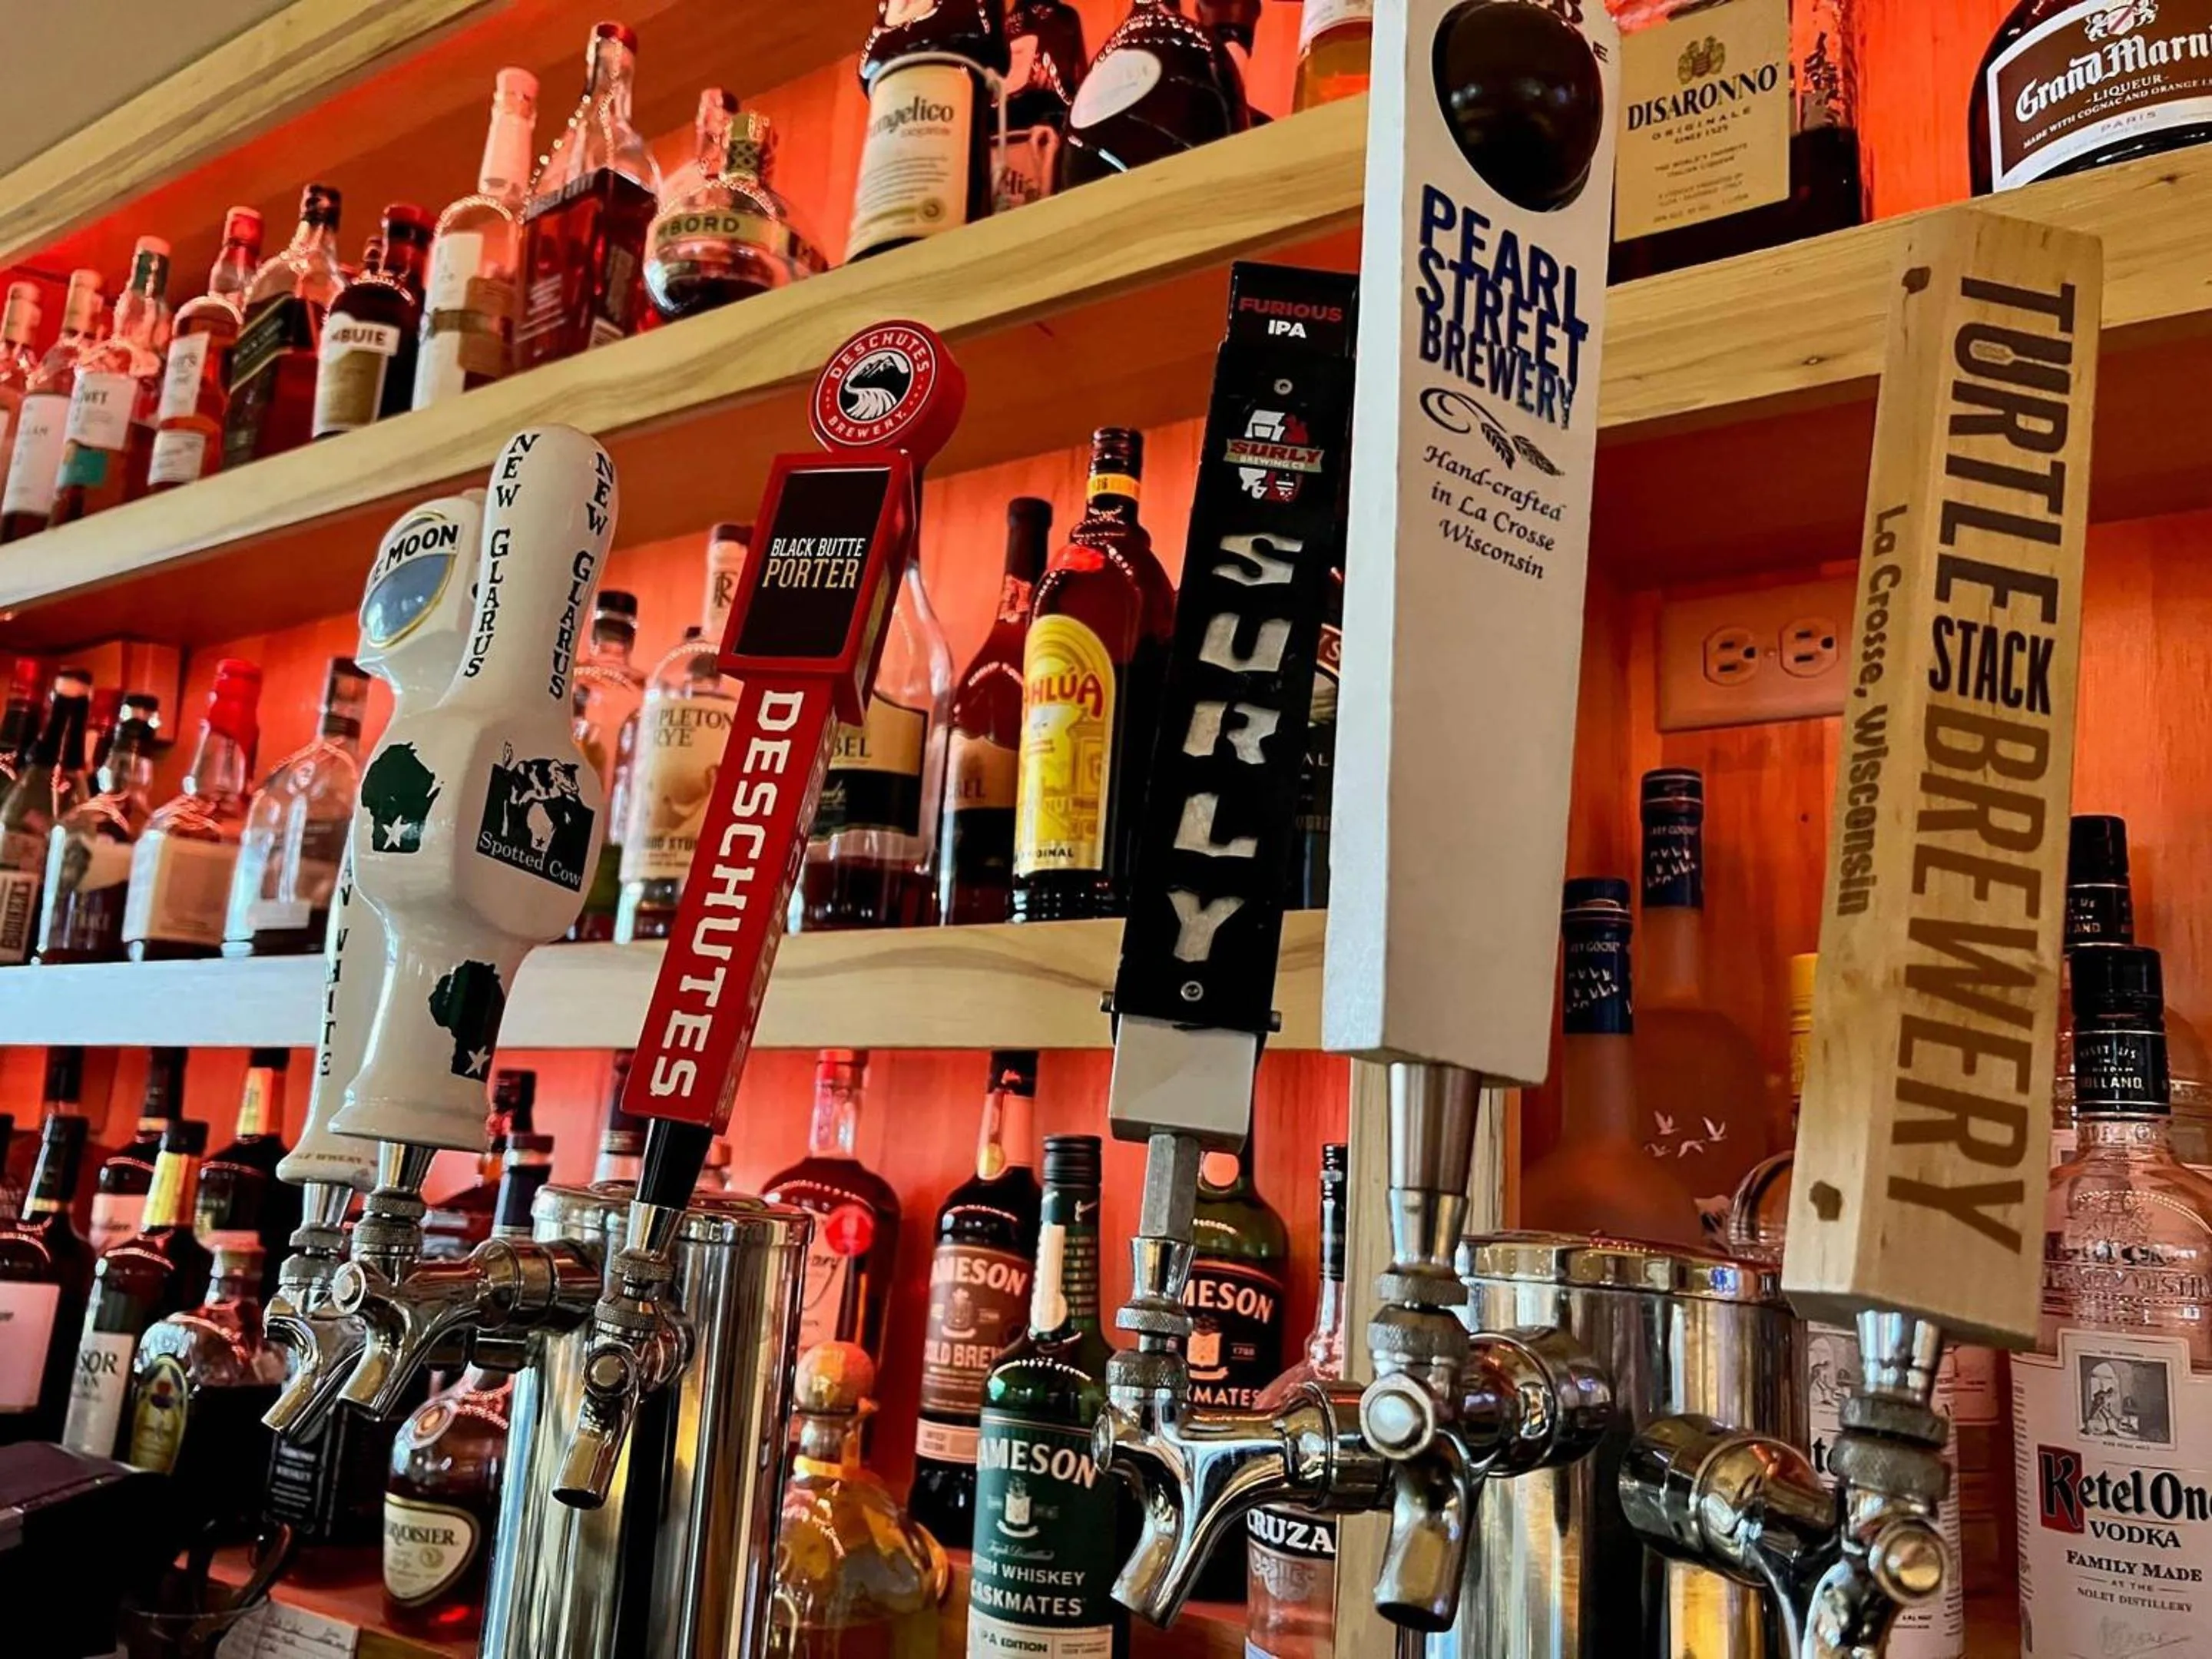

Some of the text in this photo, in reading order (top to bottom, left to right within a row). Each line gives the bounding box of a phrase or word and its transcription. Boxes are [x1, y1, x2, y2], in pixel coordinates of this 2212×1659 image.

[1628, 63, 1779, 131] DISARONNO
[2015, 51, 2103, 123] Grand
[2092, 75, 2163, 104] LIQUEUR
[2049, 114, 2075, 133] WITH
[2077, 96, 2123, 120] COGNAC
[2124, 89, 2149, 104] AND
[1238, 296, 1343, 323] FURIOUS
[1268, 319, 1306, 339] IPA
[1416, 184, 1588, 430] PEARL STREET BREWERY
[830, 332, 930, 379] DESCHUTES
[828, 411, 905, 438] BREWERY
[1230, 439, 1322, 464] SURLY
[1423, 445, 1566, 522] Hand-crafted
[1431, 482, 1555, 551] in La Crosse
[386, 525, 459, 571] MOON
[464, 434, 541, 677] NEW GLARUS
[770, 538, 866, 558] BLACK BUTTE
[1439, 518, 1544, 579] Wisconsin
[548, 452, 614, 700] NEW GLARUS
[762, 558, 859, 589] PORTER
[1025, 666, 1104, 719] HLÚA
[1836, 504, 1908, 917] La Crosse, Wisconsin
[659, 707, 734, 729] PLETON
[1167, 533, 1303, 962] SURLY
[1886, 276, 2077, 1256] TURTLE STACK BREWERY
[479, 831, 581, 886] Spotted Cow
[650, 690, 804, 1098] DESCHUTES
[1182, 1279, 1274, 1324] MESON
[2039, 1451, 2212, 1529] Ketel On
[1247, 1508, 1336, 1554] CRUZA
[2088, 1520, 2181, 1548] VODKA
[1002, 1564, 1086, 1587] WHISKEY
[2066, 1549, 2203, 1582] FAMILY MADE
[2111, 1579, 2154, 1592] AT THE
[2077, 1587, 2193, 1613] NOLET DISTILLERY
[1001, 1637, 1048, 1654] EDITION
